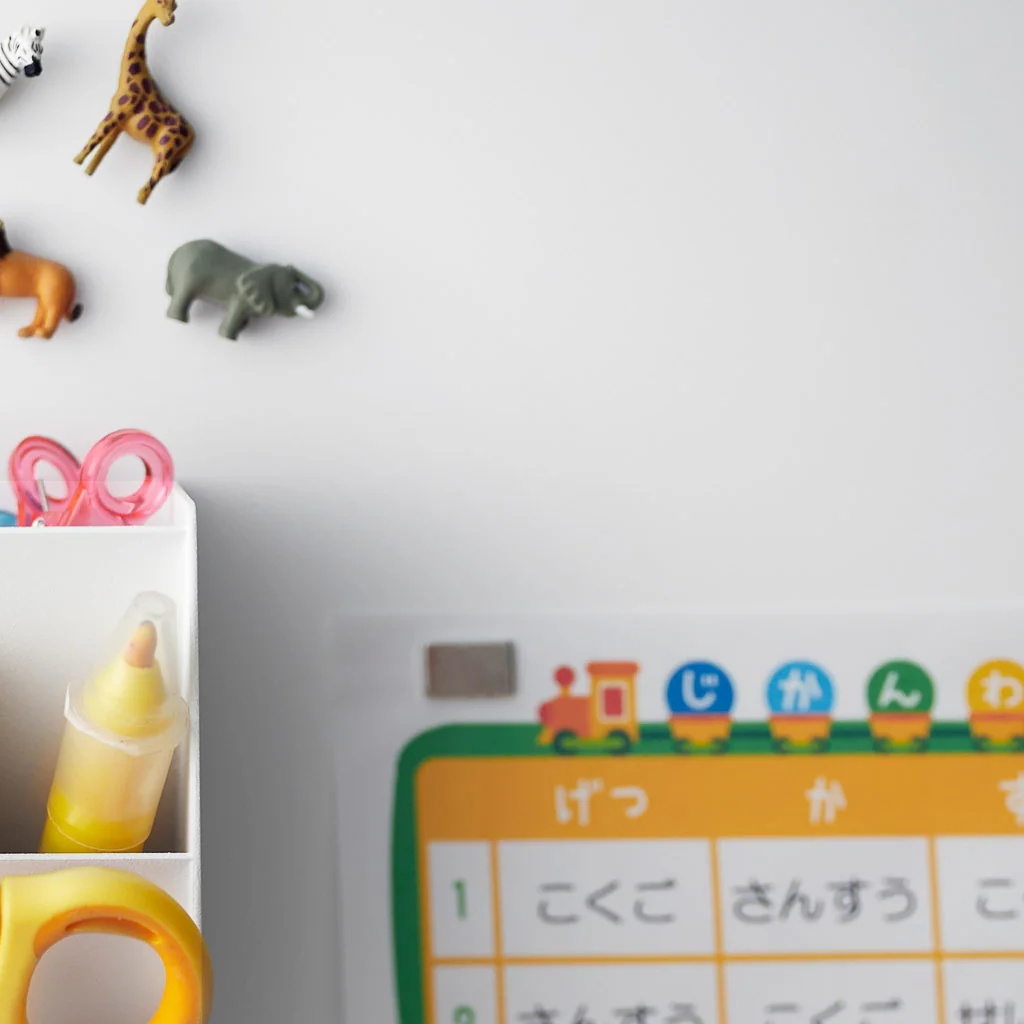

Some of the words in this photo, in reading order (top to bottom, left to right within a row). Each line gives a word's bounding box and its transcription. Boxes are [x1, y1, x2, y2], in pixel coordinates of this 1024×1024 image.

[554, 777, 649, 826] げつ
[805, 777, 847, 824] か
[453, 879, 468, 920] 1
[536, 877, 679, 925] こくご
[731, 876, 918, 925] さんすう
